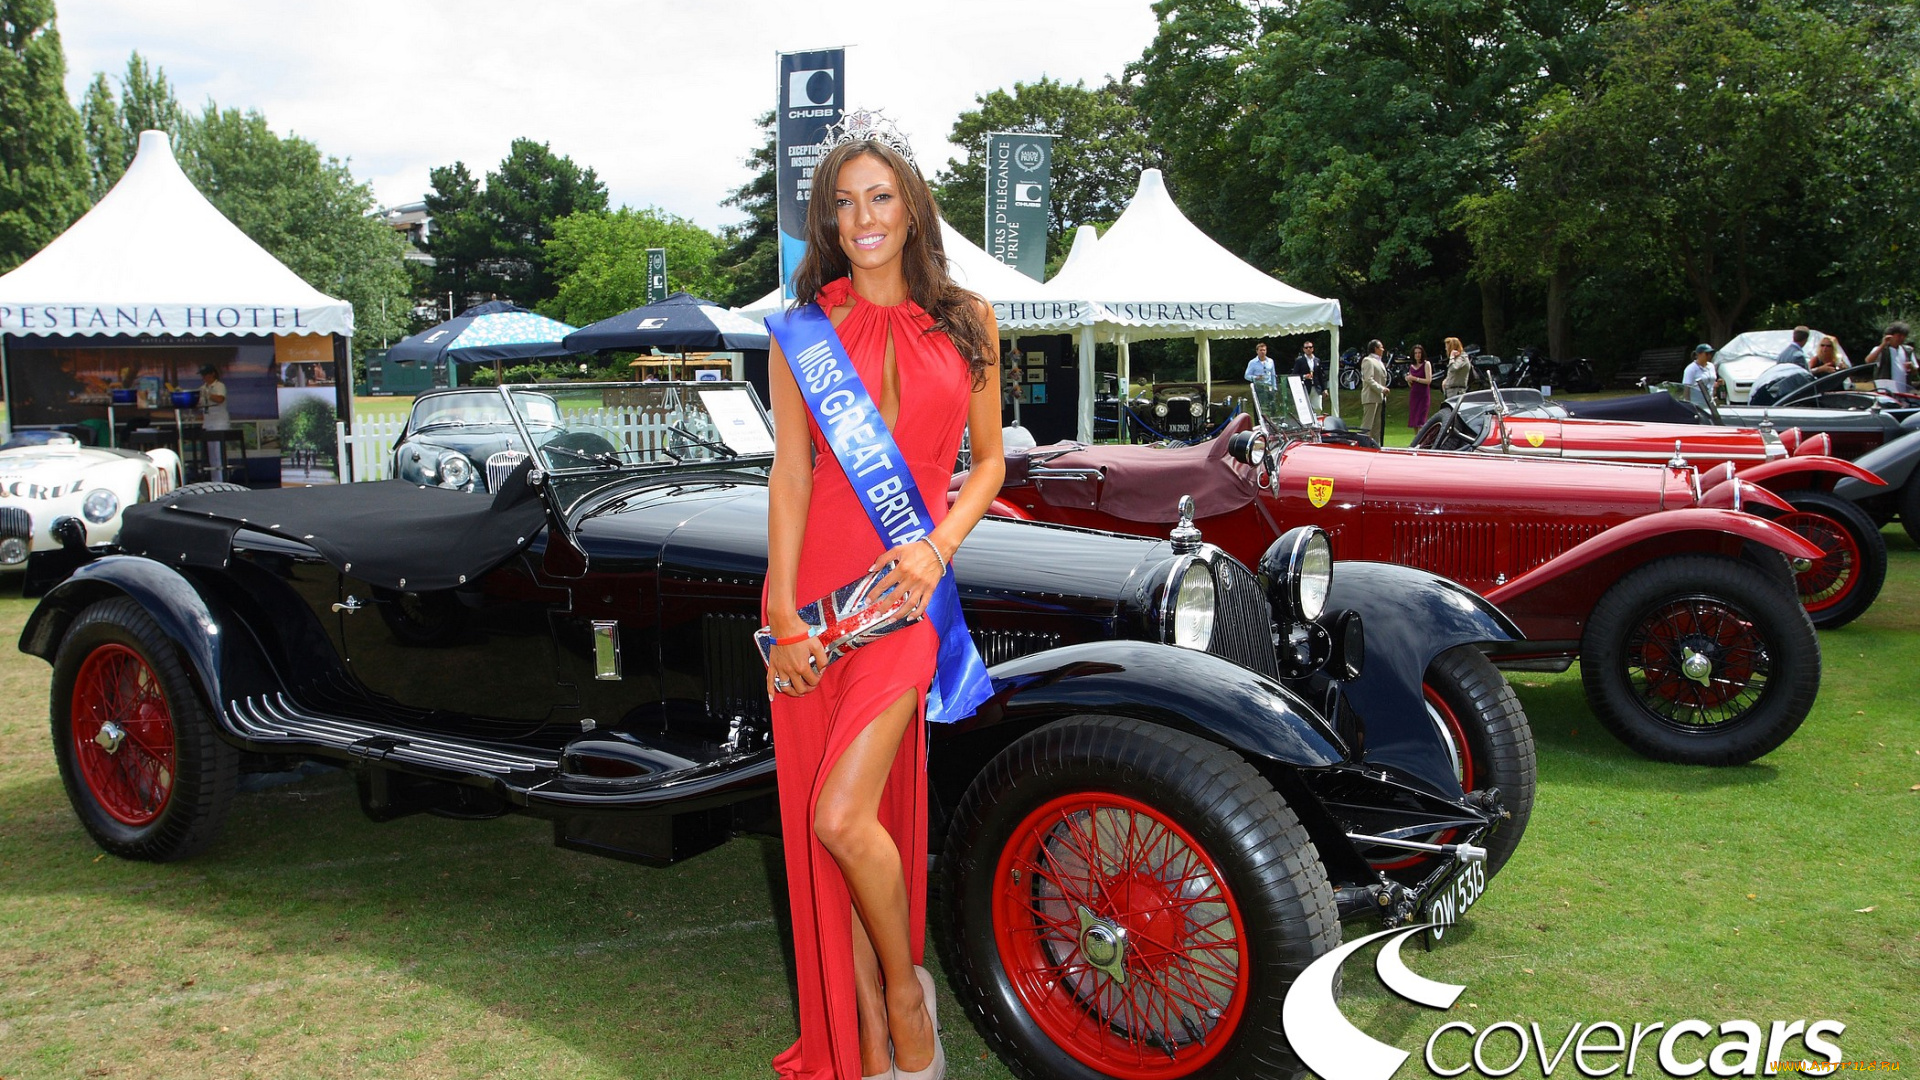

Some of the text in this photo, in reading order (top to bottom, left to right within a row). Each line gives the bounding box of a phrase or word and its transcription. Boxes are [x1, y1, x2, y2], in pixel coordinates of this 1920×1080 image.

[789, 109, 833, 119] CHUBB
[797, 190, 804, 201] &
[994, 228, 1006, 263] OURS
[0, 307, 308, 328] PESTANA HOTEL
[992, 303, 1236, 320] CHUBB NSURANCE
[796, 340, 926, 545] MISS GREAT BRITA
[1433, 861, 1484, 940] OW 5313
